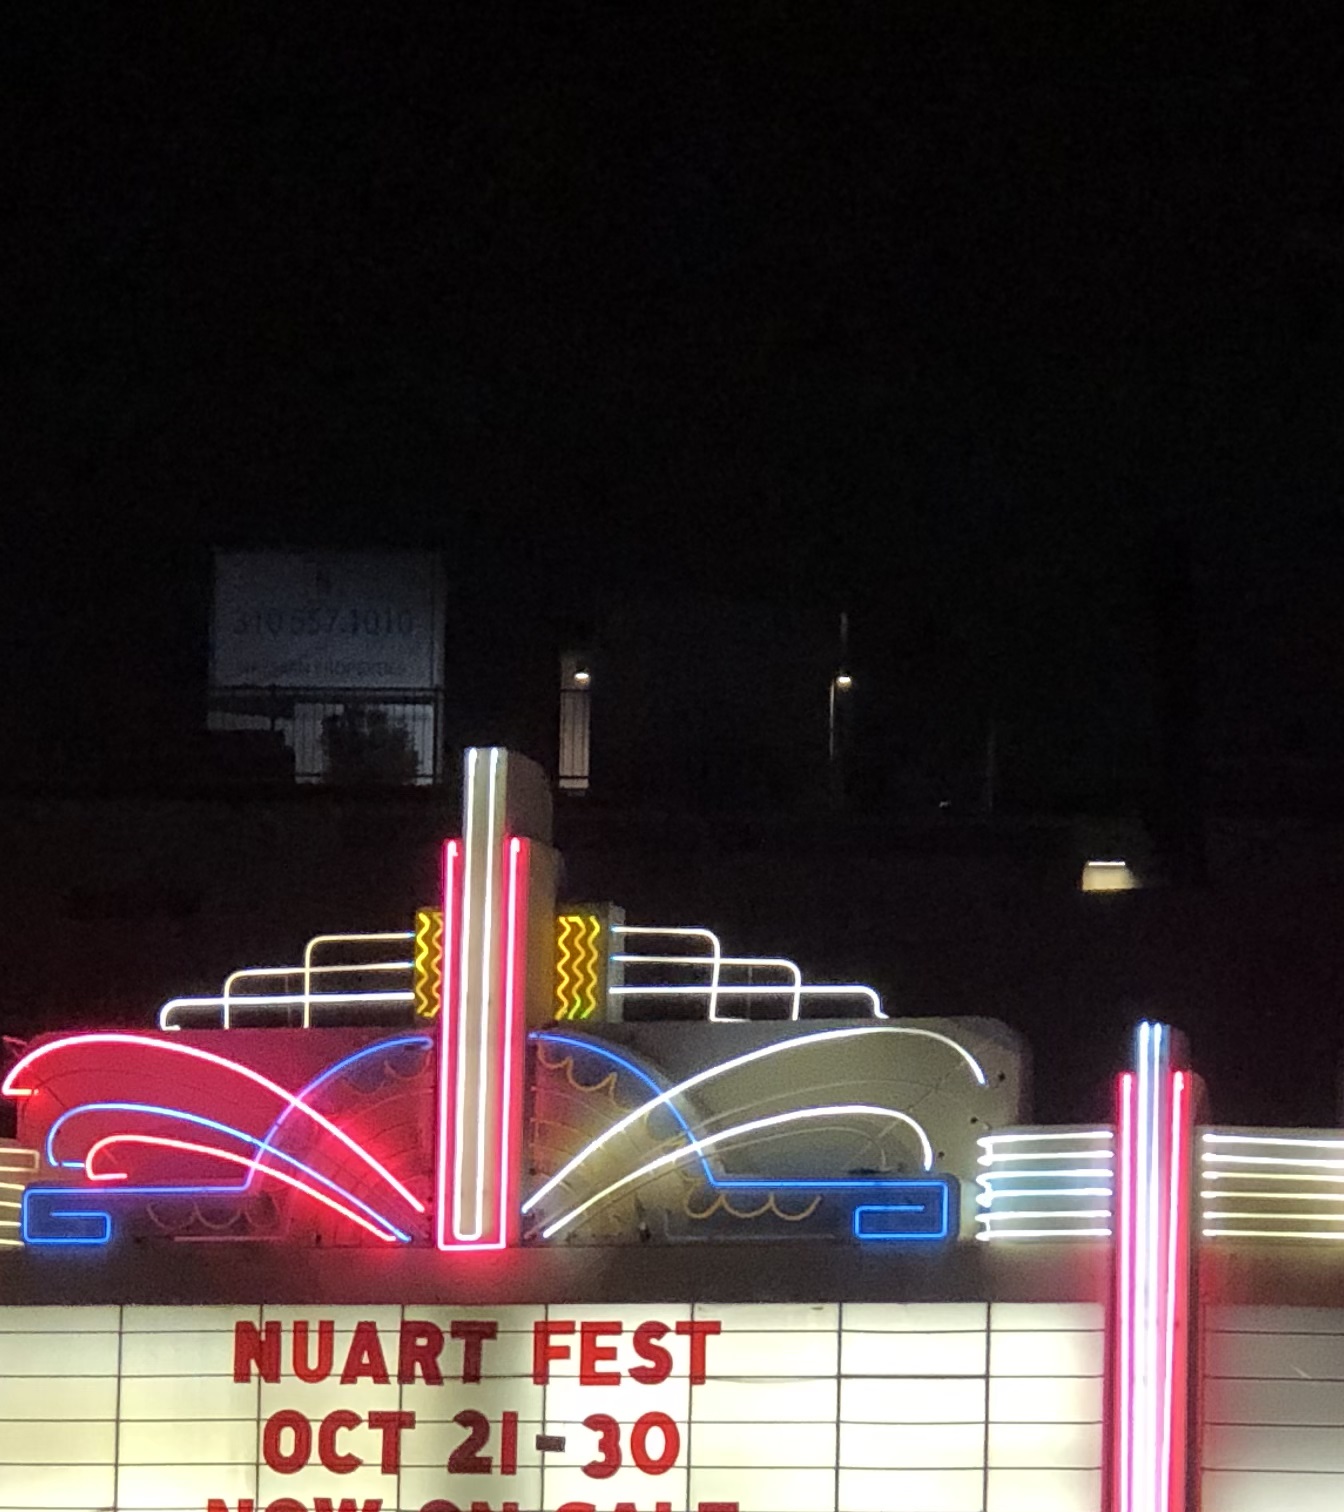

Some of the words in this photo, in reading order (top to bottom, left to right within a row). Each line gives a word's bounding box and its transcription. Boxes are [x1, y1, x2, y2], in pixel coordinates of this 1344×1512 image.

[233, 1320, 498, 1386] NUART
[532, 1320, 722, 1387] FEST
[262, 1409, 416, 1477] OCT
[447, 1409, 681, 1480] 21-30
